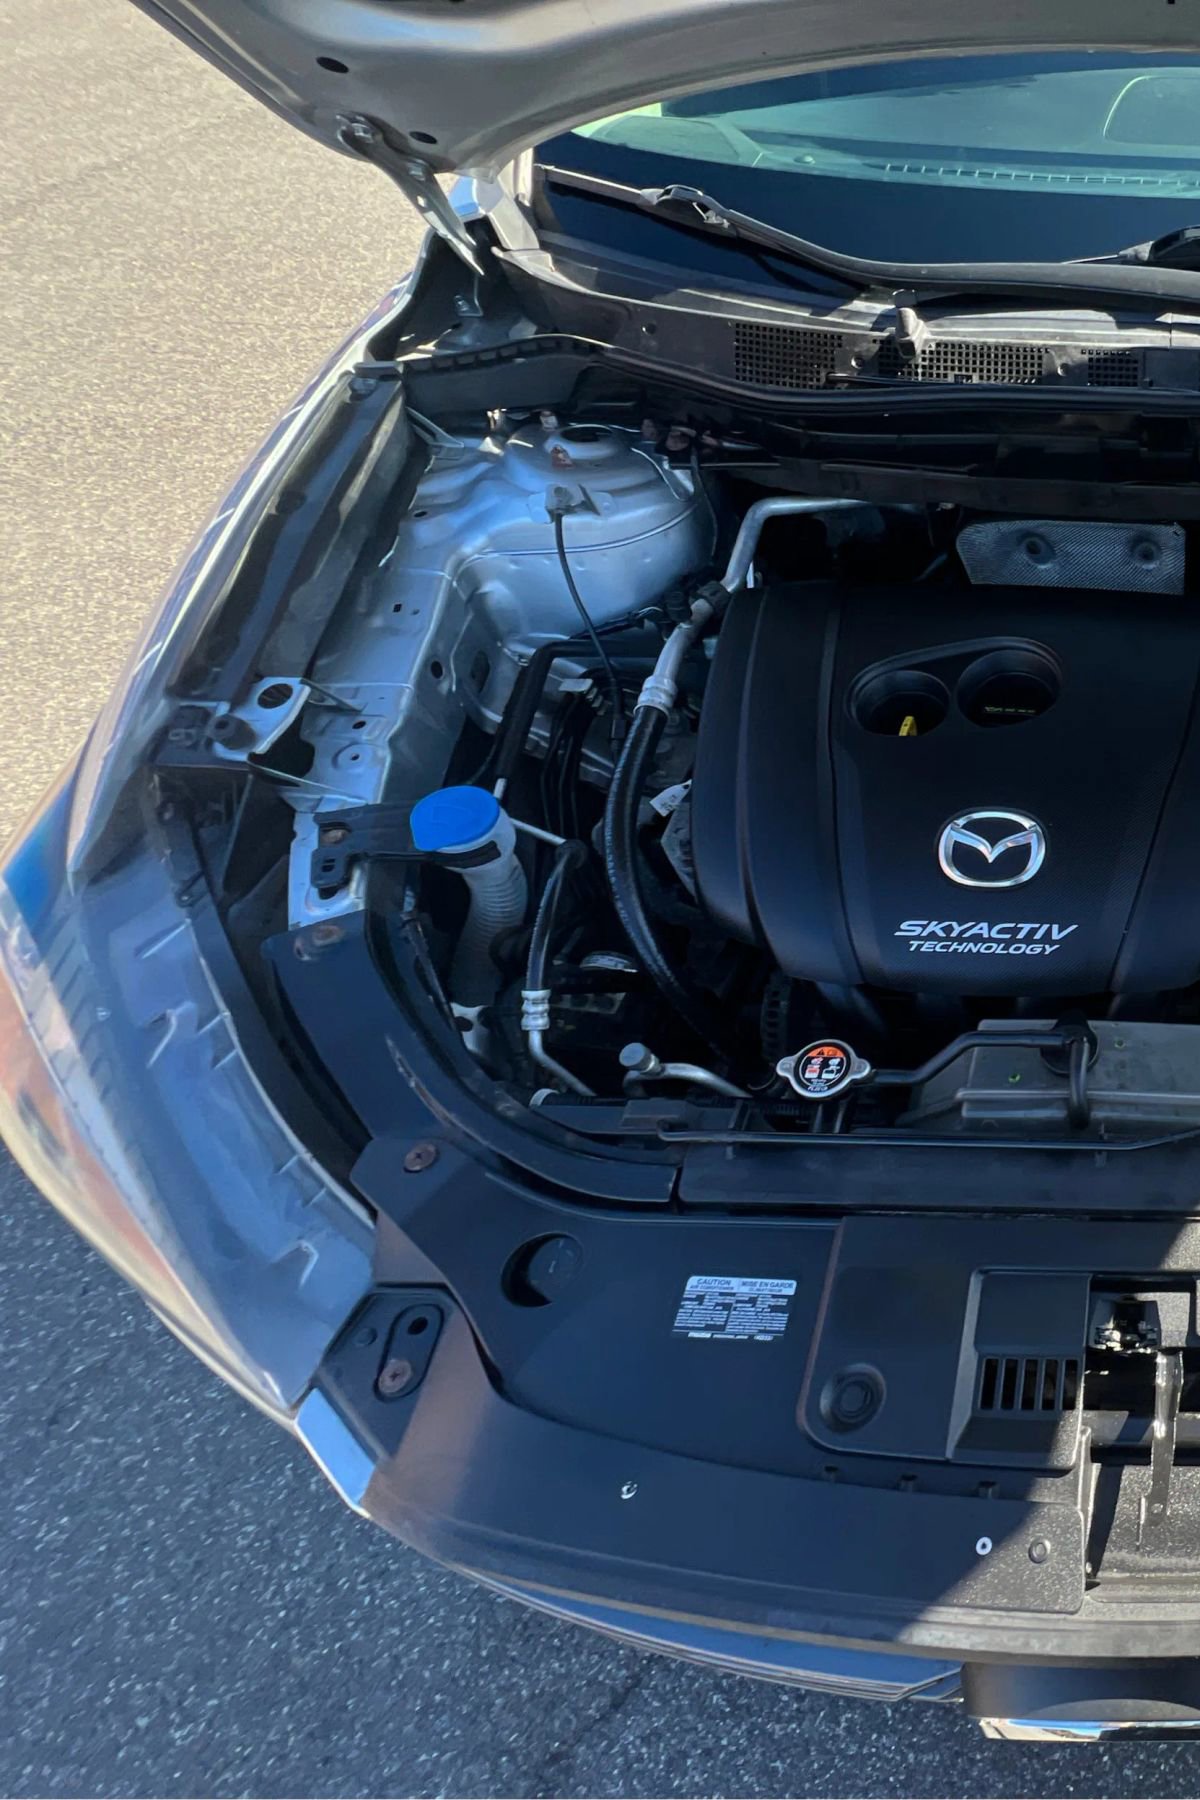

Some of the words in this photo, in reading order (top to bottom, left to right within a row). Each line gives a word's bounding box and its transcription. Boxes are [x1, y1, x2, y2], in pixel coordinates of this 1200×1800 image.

[894, 920, 1079, 940] SKYACTIV
[908, 940, 1061, 955] TECHNOLOGY
[697, 1278, 731, 1286] CAUTION
